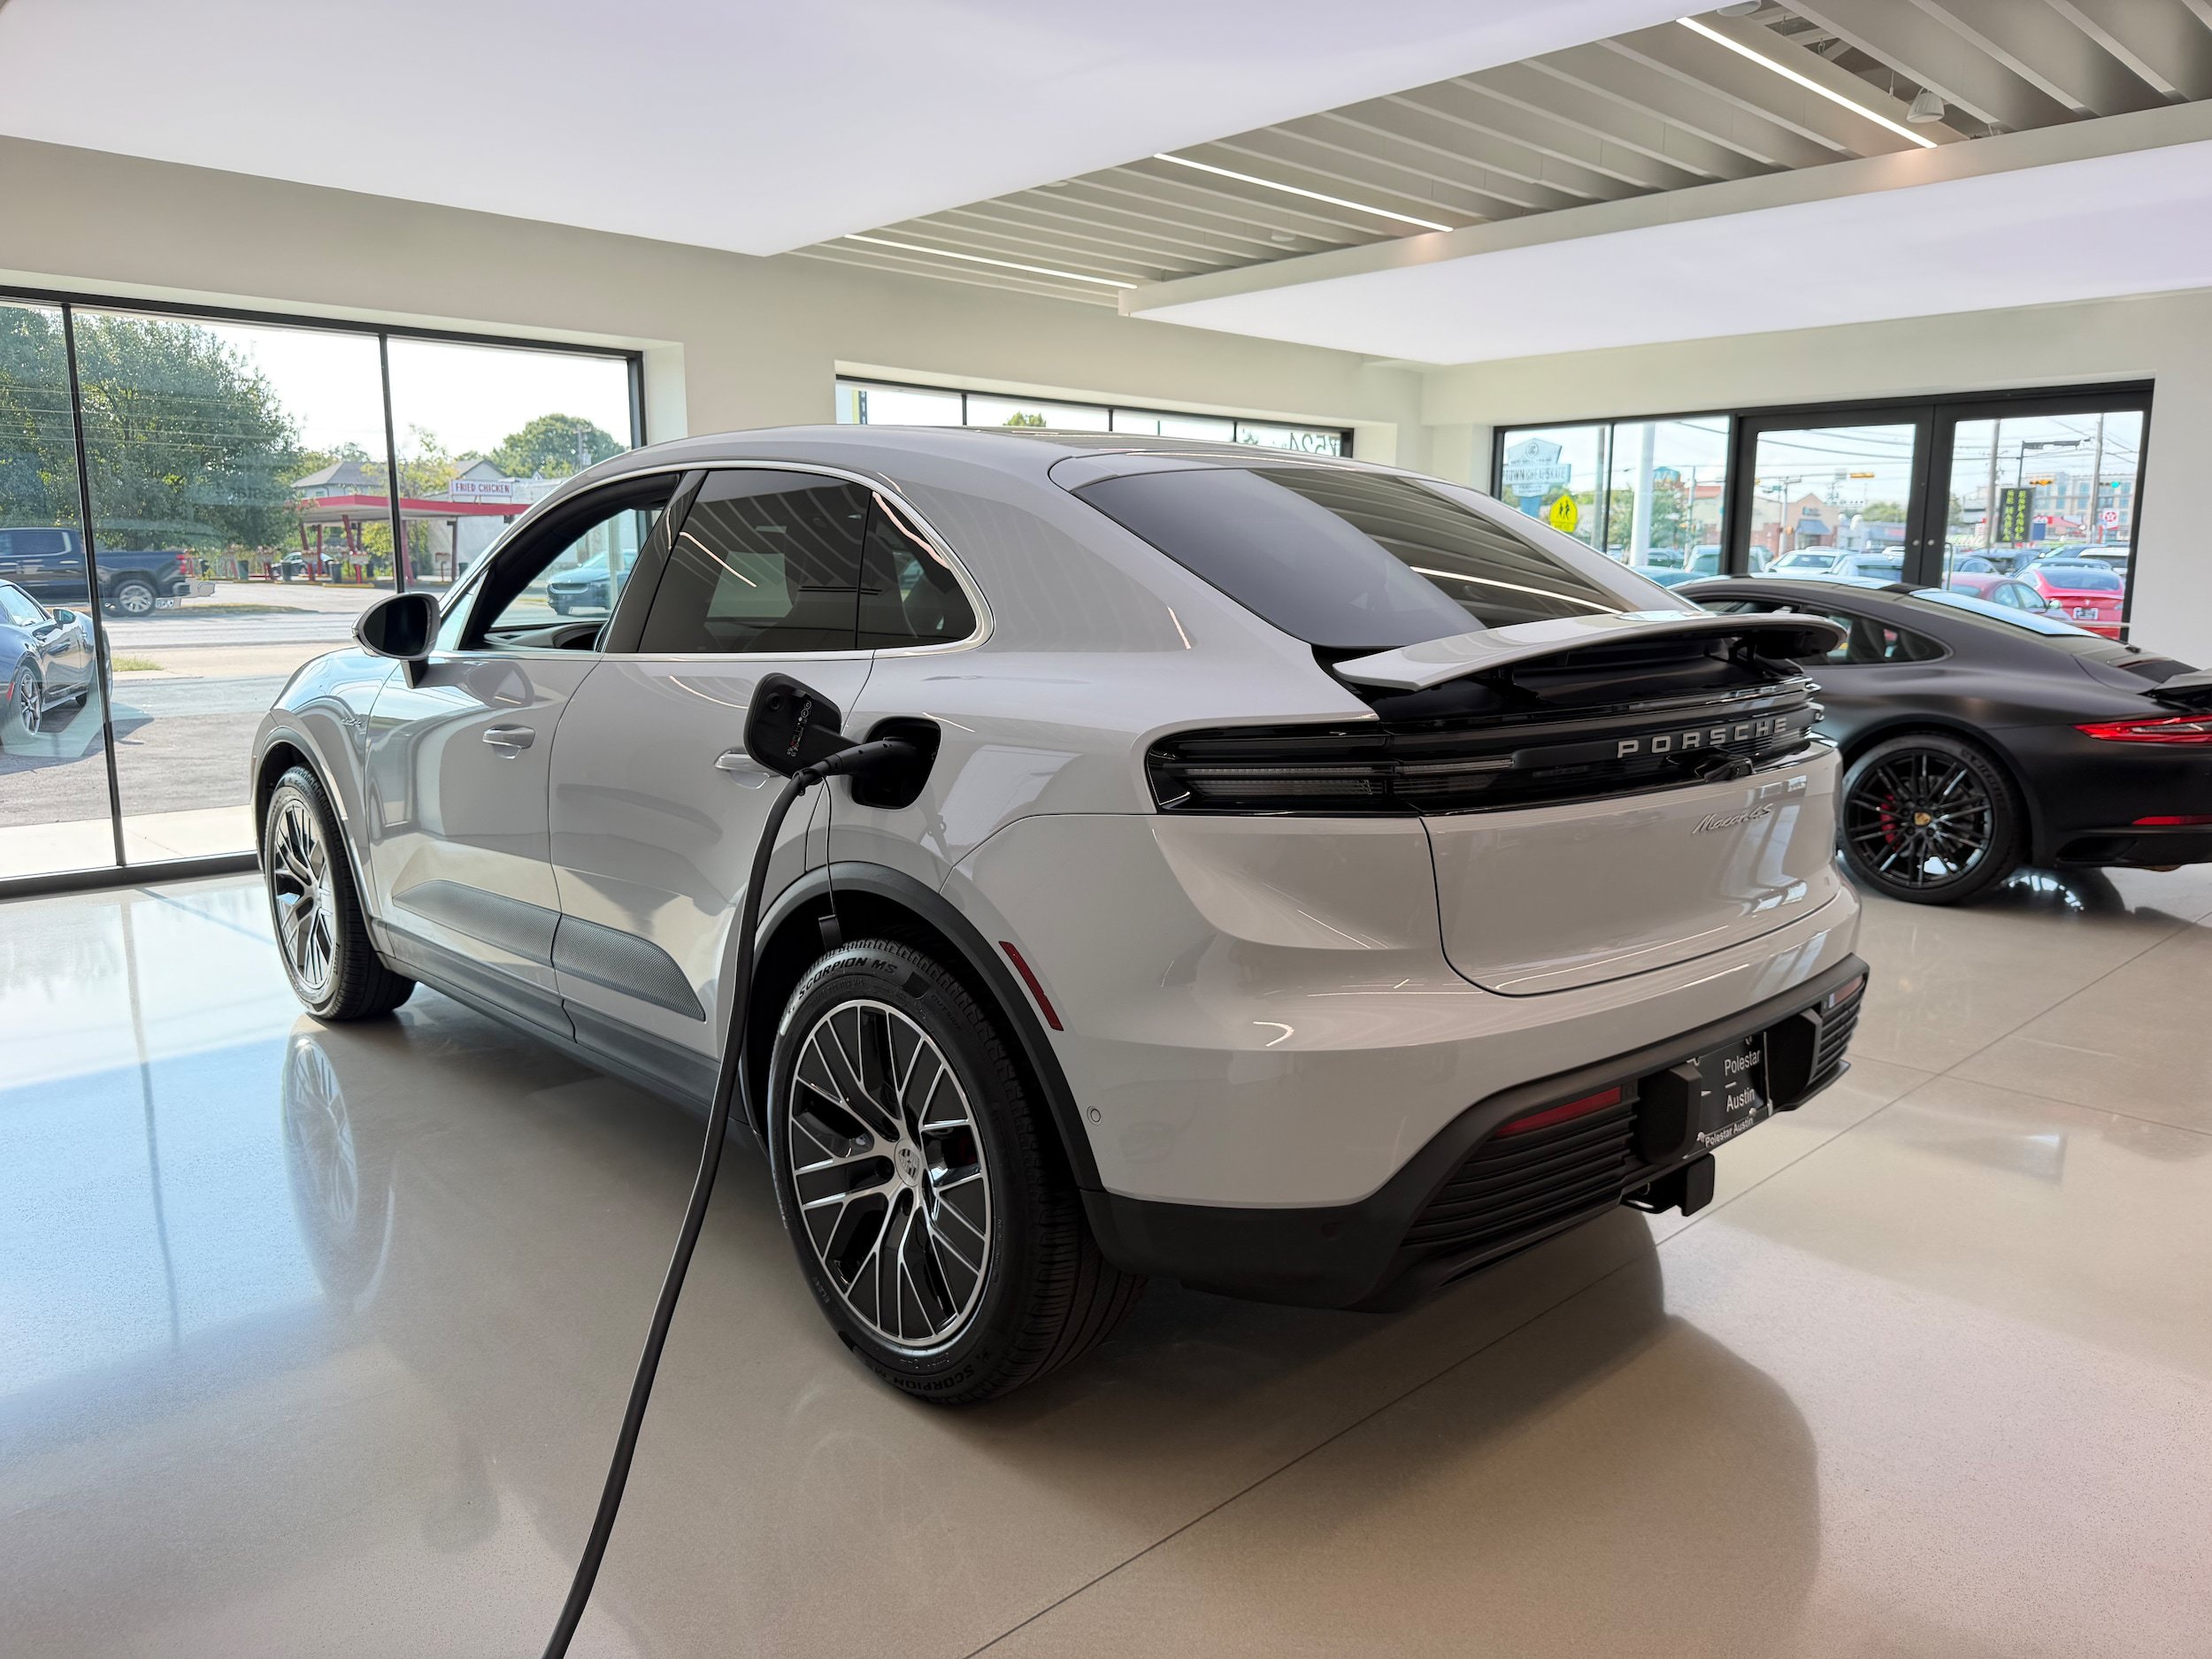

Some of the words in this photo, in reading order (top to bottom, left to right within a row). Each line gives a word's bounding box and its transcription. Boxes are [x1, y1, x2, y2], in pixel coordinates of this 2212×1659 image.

[456, 482, 476, 492] FRIED
[478, 483, 510, 493] CHICKEN
[1617, 717, 1786, 758] PORSCHE
[798, 956, 868, 1001] SCORPION
[873, 959, 898, 974] MS
[1724, 1049, 1761, 1076] Polestar
[1726, 1087, 1755, 1112] Austin
[1705, 1127, 1733, 1148] Polestar
[1733, 1116, 1754, 1135] Austin
[893, 1363, 974, 1391] SCORPION
